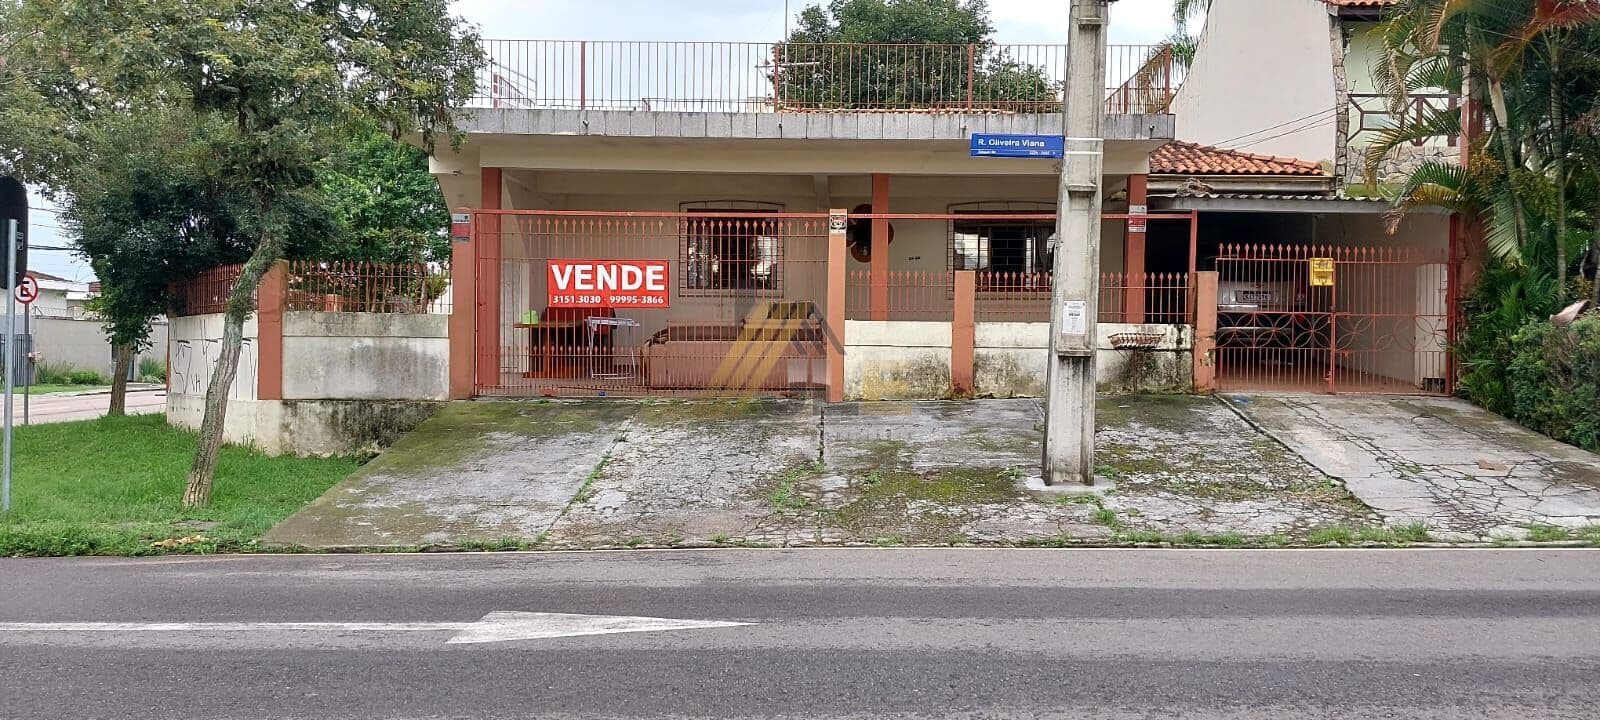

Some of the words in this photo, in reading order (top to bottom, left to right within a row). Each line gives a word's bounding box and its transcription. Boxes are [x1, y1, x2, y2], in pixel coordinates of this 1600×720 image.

[978, 138, 987, 147] R.
[988, 138, 1020, 147] Oliveira
[1022, 139, 1045, 147] Viana
[551, 264, 665, 291] VENDE
[553, 295, 601, 304] 3151.3030
[609, 295, 664, 305] 99995-3866
